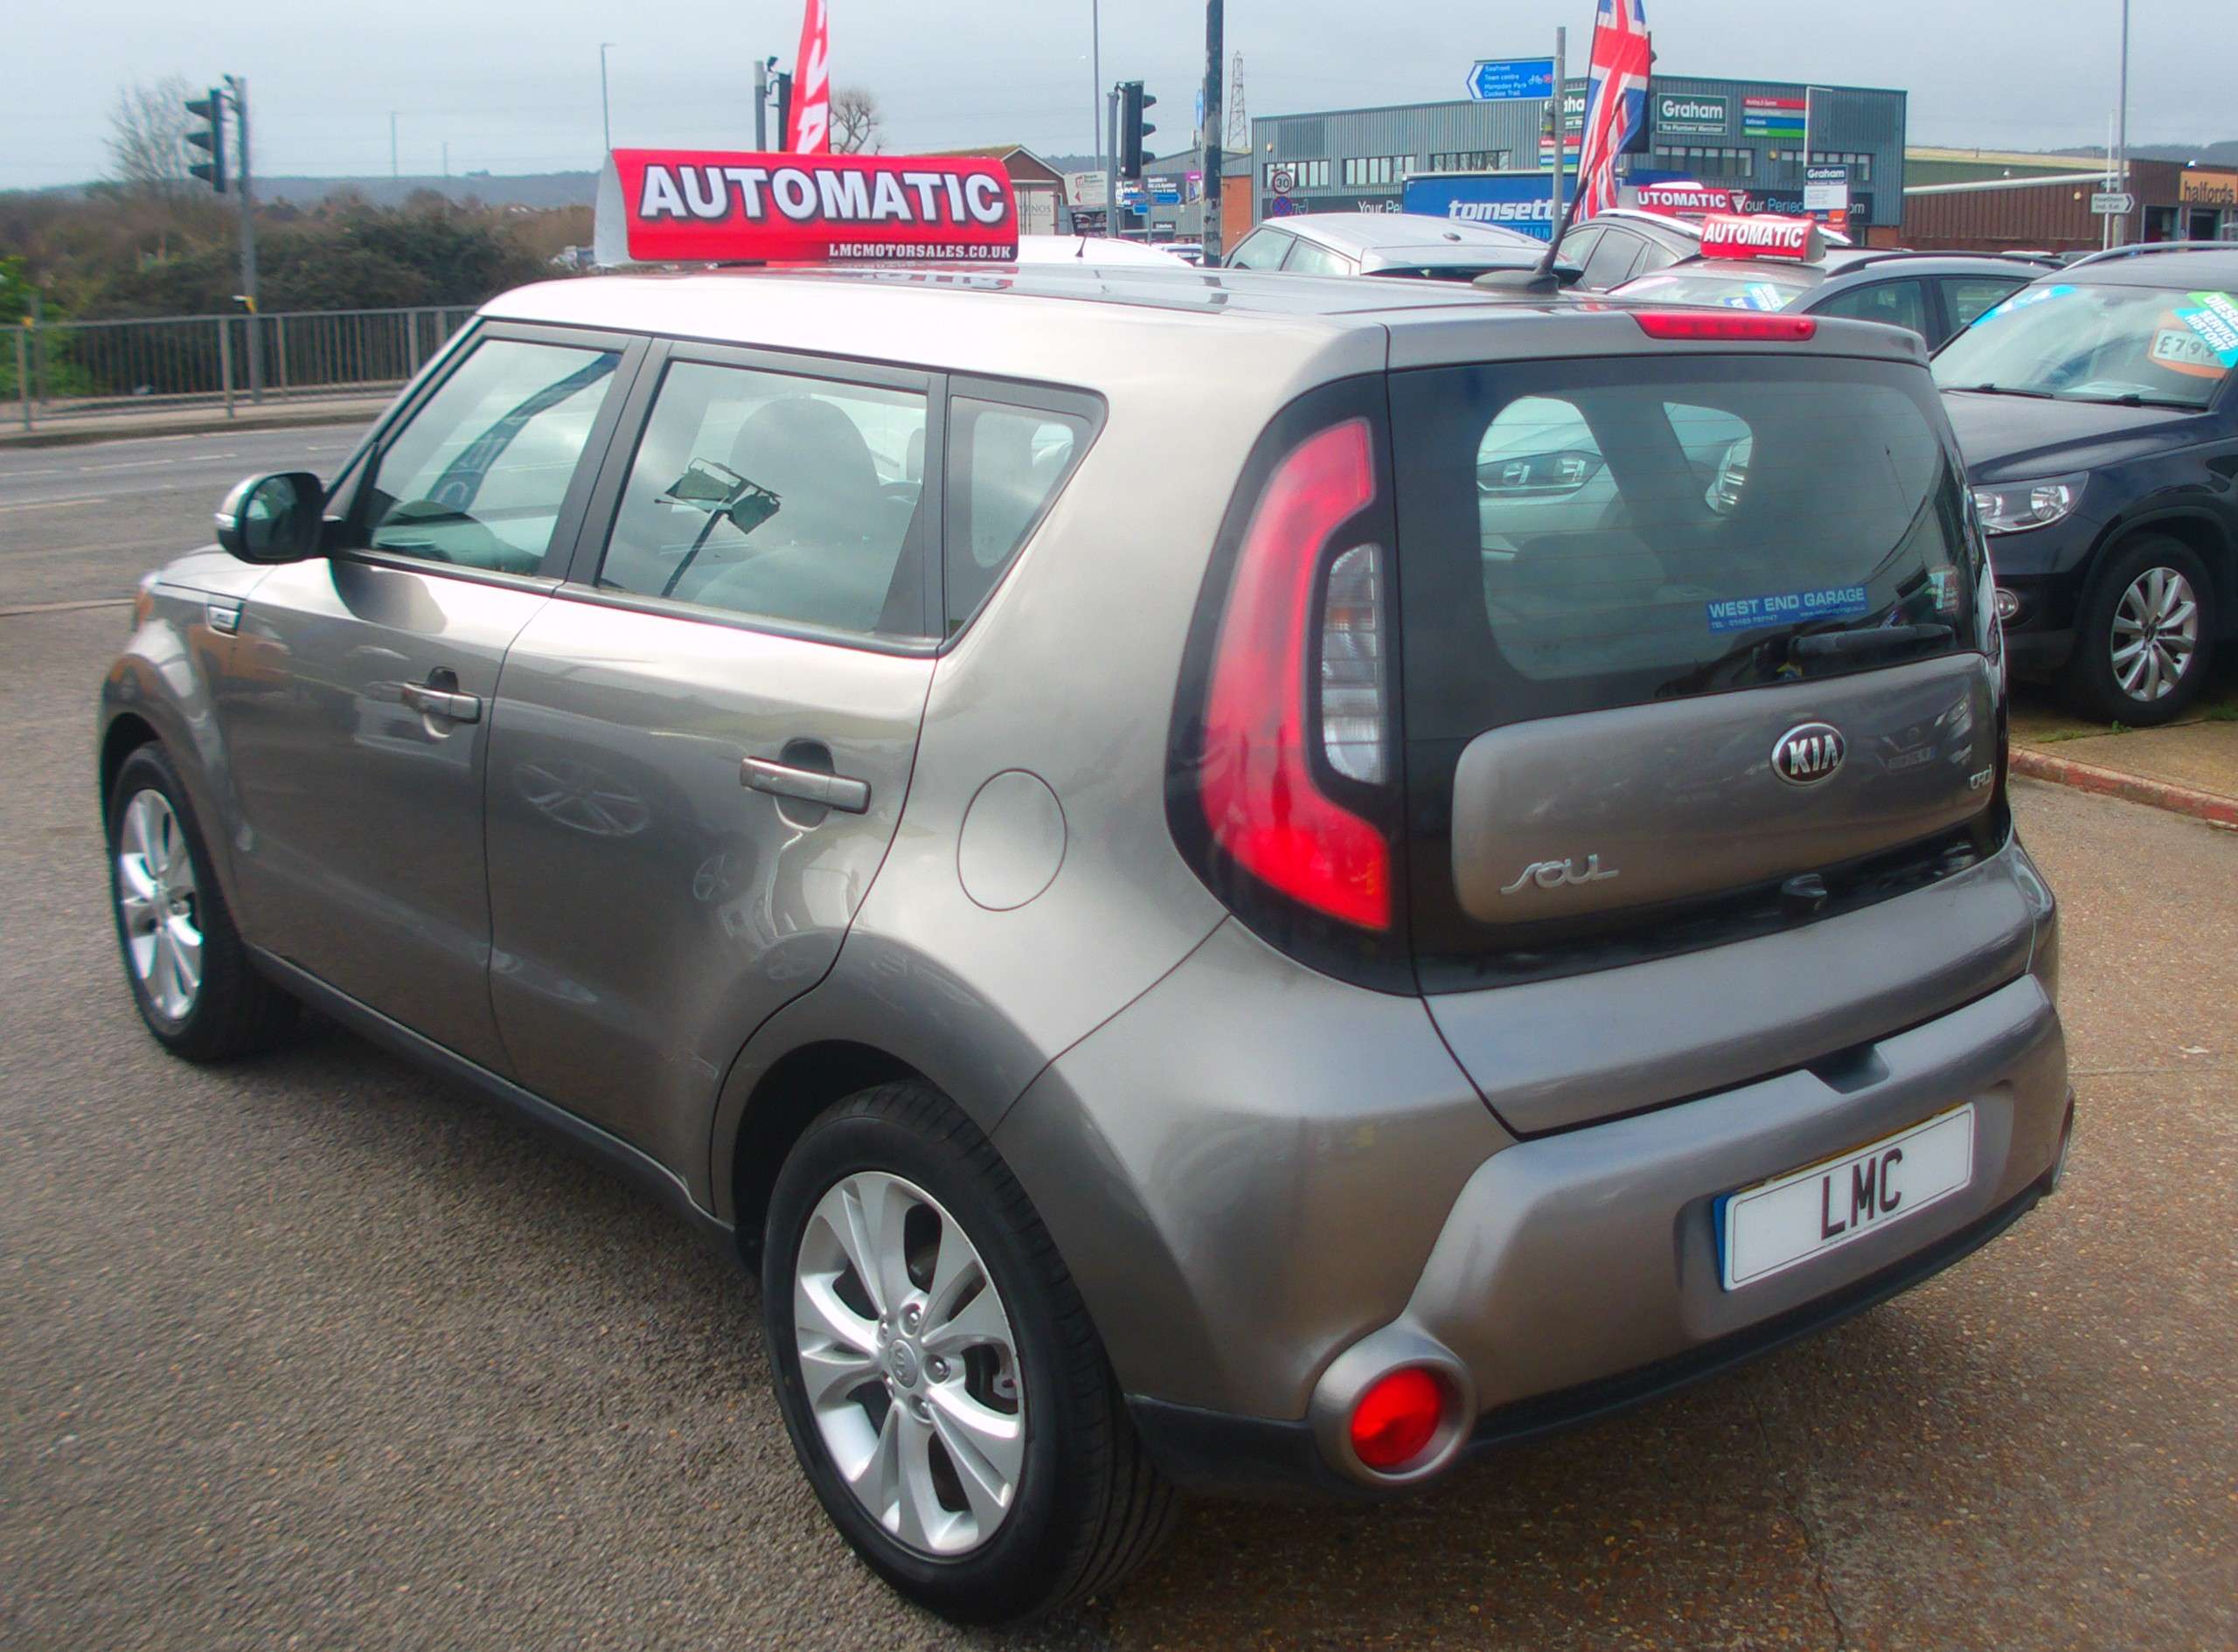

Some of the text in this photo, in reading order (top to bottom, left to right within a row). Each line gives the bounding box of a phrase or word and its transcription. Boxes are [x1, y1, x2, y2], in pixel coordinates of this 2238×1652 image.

[1662, 100, 1723, 119] Graham
[1275, 177, 1290, 188] 30
[1806, 169, 1845, 179] Graham
[640, 165, 1004, 223] AUTOMATIC
[1637, 191, 1727, 208] UTOMATIC
[2184, 180, 2234, 204] halfords
[1448, 198, 1572, 220] tomsetts
[1768, 198, 1804, 213] Perfec
[1703, 223, 1804, 248] AUTOMATIC
[829, 243, 1011, 259] LMCMOTORSALES.CO.UK
[2184, 314, 2231, 351] HISTORY
[1708, 587, 1865, 619] WEST END GARAGE
[1787, 734, 1838, 775] KIA
[1821, 1148, 1903, 1241] LMC
